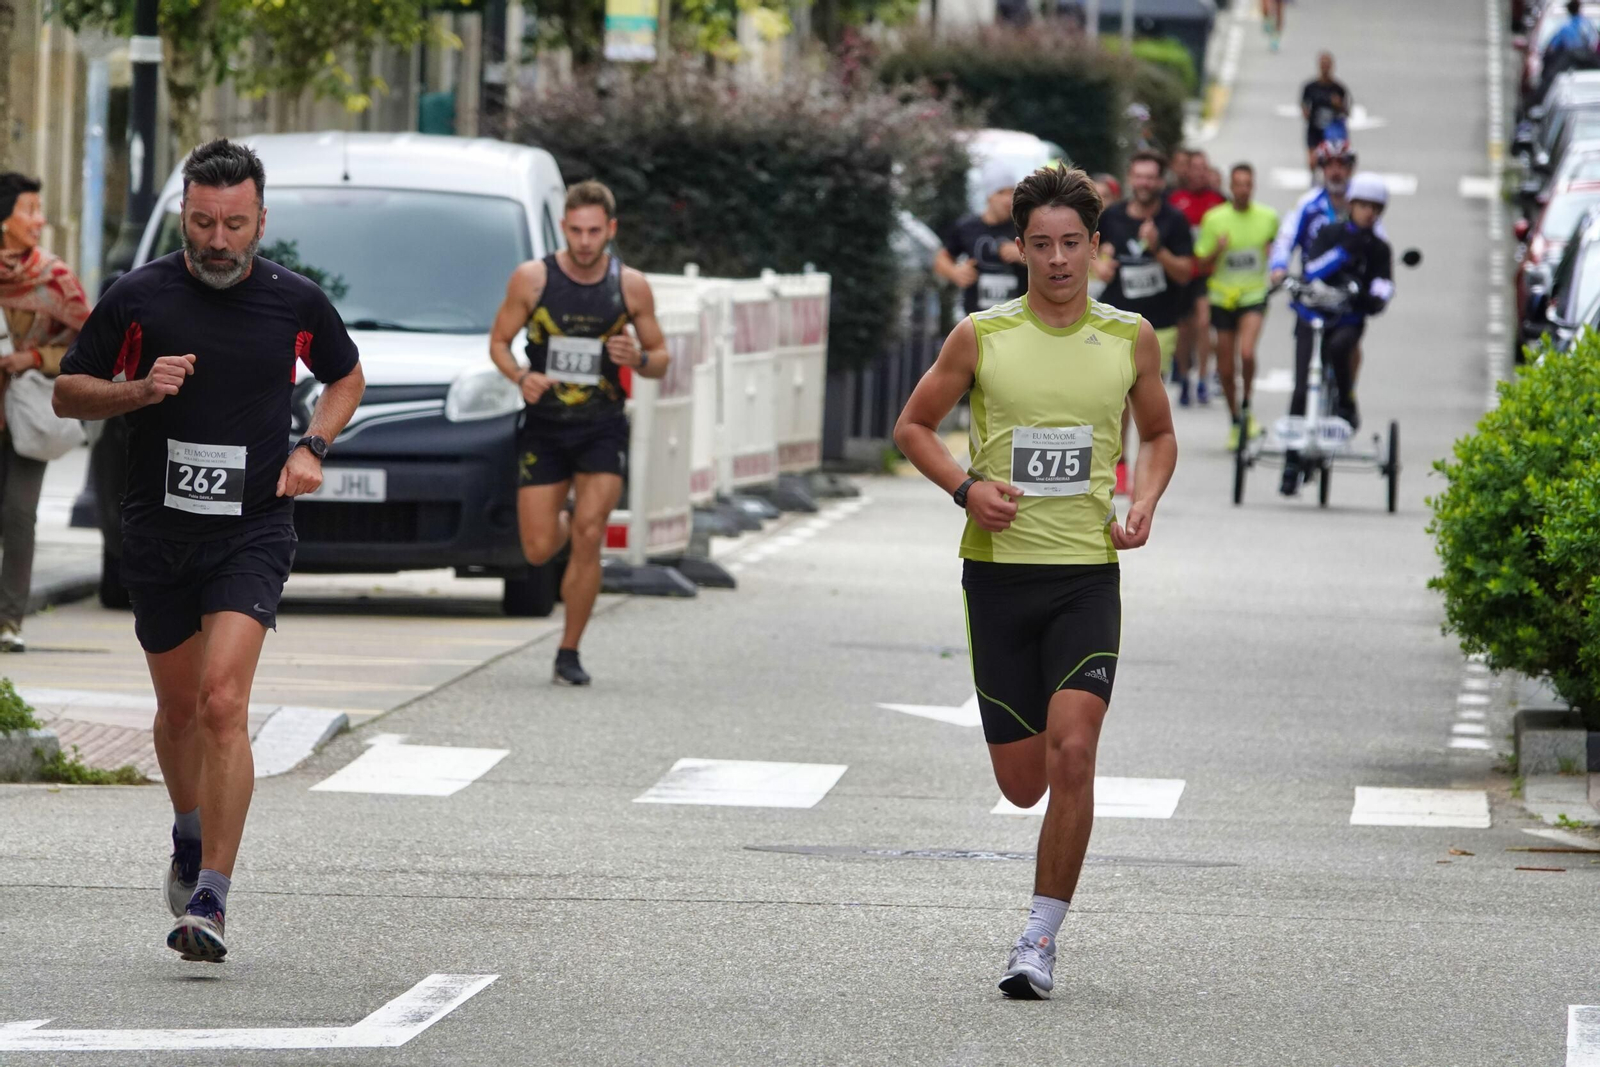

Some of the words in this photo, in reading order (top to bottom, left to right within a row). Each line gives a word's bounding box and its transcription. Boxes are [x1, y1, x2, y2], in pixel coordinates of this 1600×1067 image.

[1027, 450, 1080, 477] 675
[178, 465, 228, 495] 262
[332, 474, 377, 496] JHL
[1084, 672, 1109, 684] adidas
